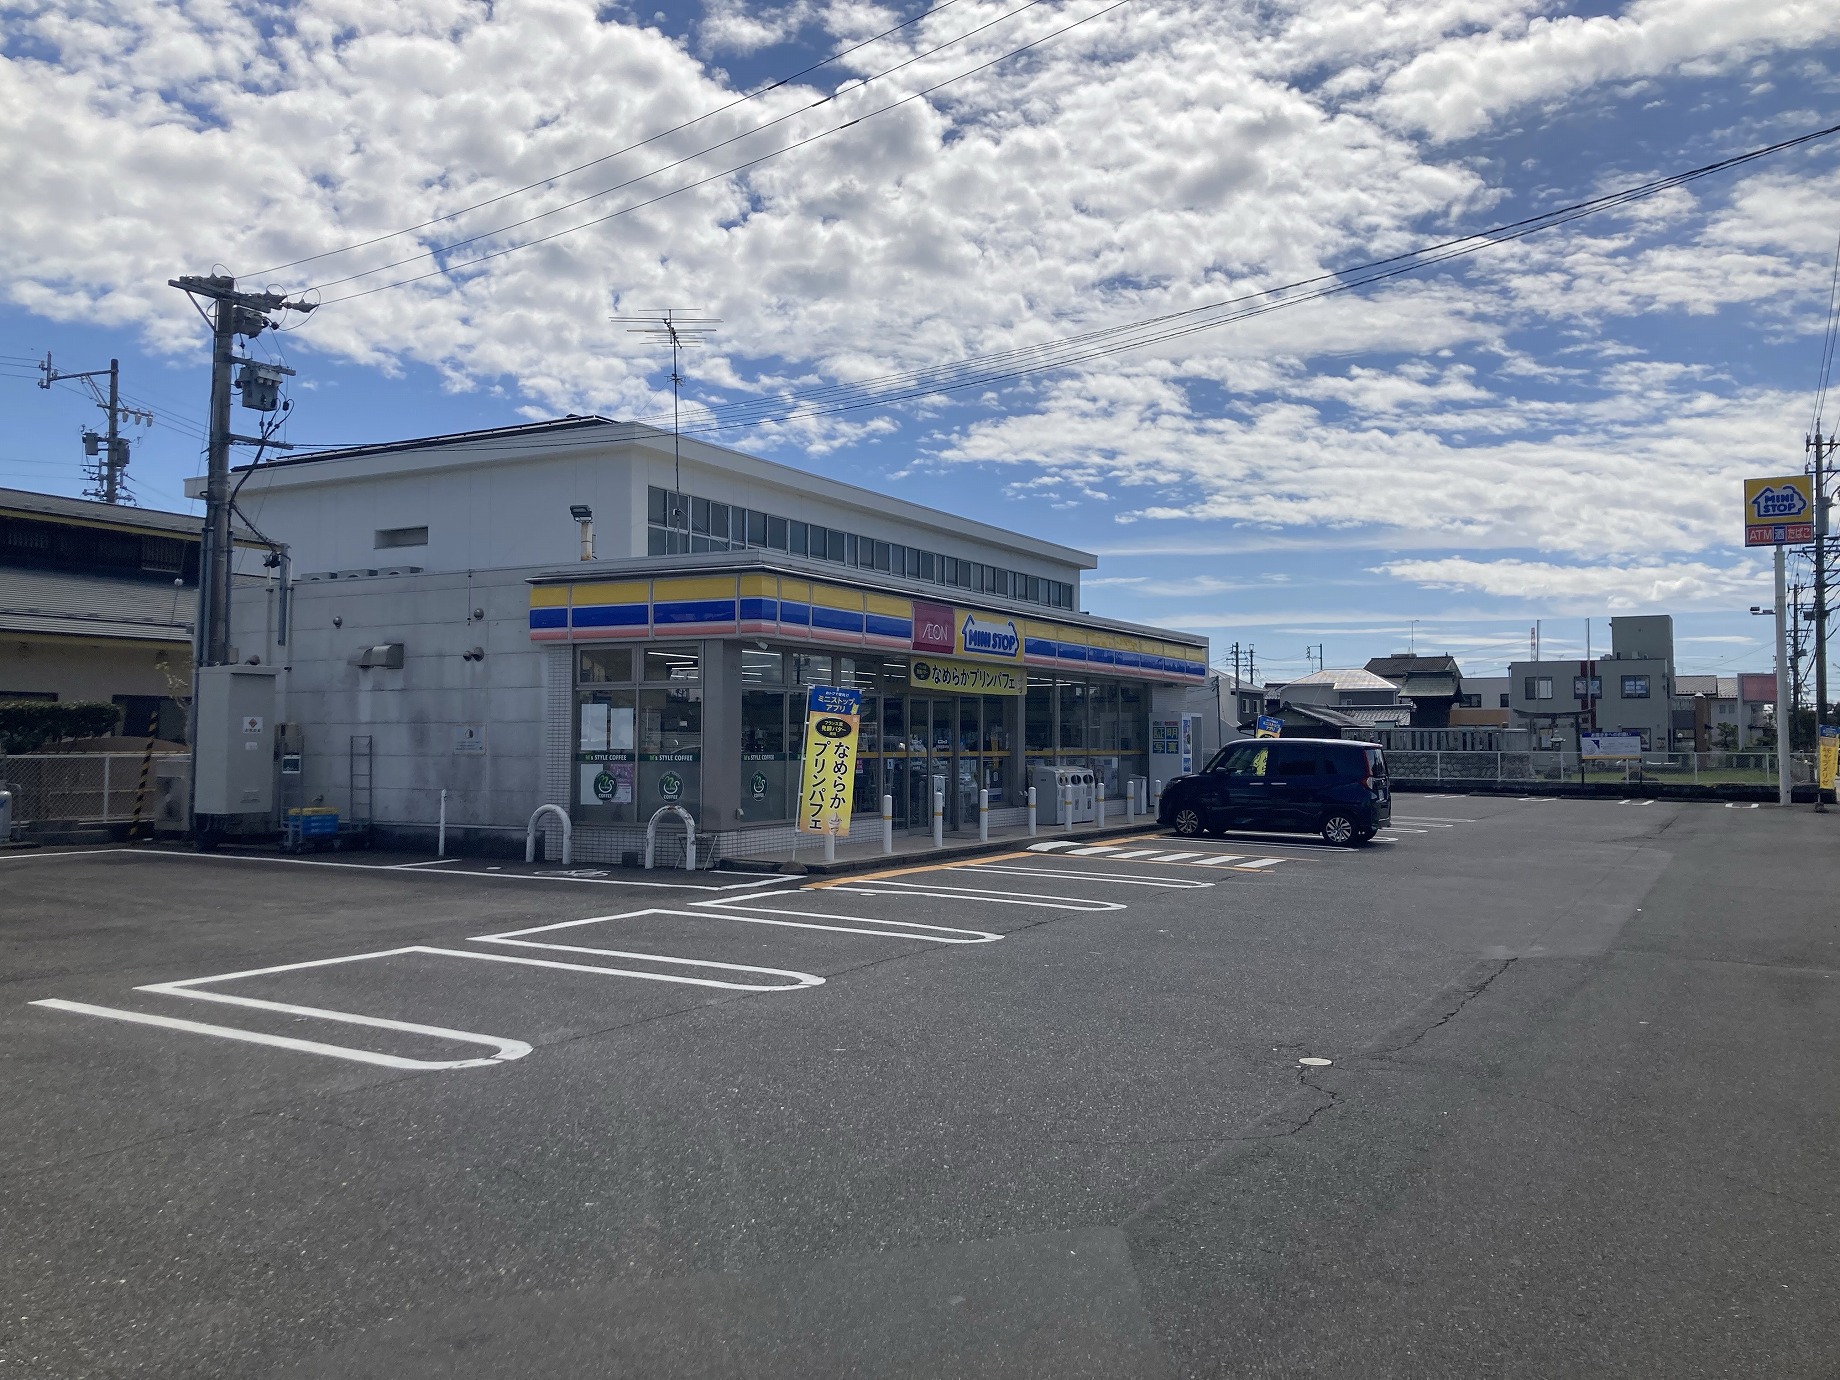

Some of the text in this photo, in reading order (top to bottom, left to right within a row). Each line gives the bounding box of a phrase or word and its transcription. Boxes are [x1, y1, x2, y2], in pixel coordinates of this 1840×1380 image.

[1764, 494, 1795, 503] MINI
[1763, 503, 1796, 513] STOP
[1749, 529, 1773, 541] ATM
[1787, 527, 1811, 539] たばこ
[968, 629, 1016, 651] MINI STOP
[932, 664, 1016, 689] なめらかプリンパフェ
[818, 695, 855, 705] ミニストップ
[826, 704, 846, 713] アプリ
[829, 742, 850, 809] なめらか
[809, 740, 831, 830] プリンパフェ
